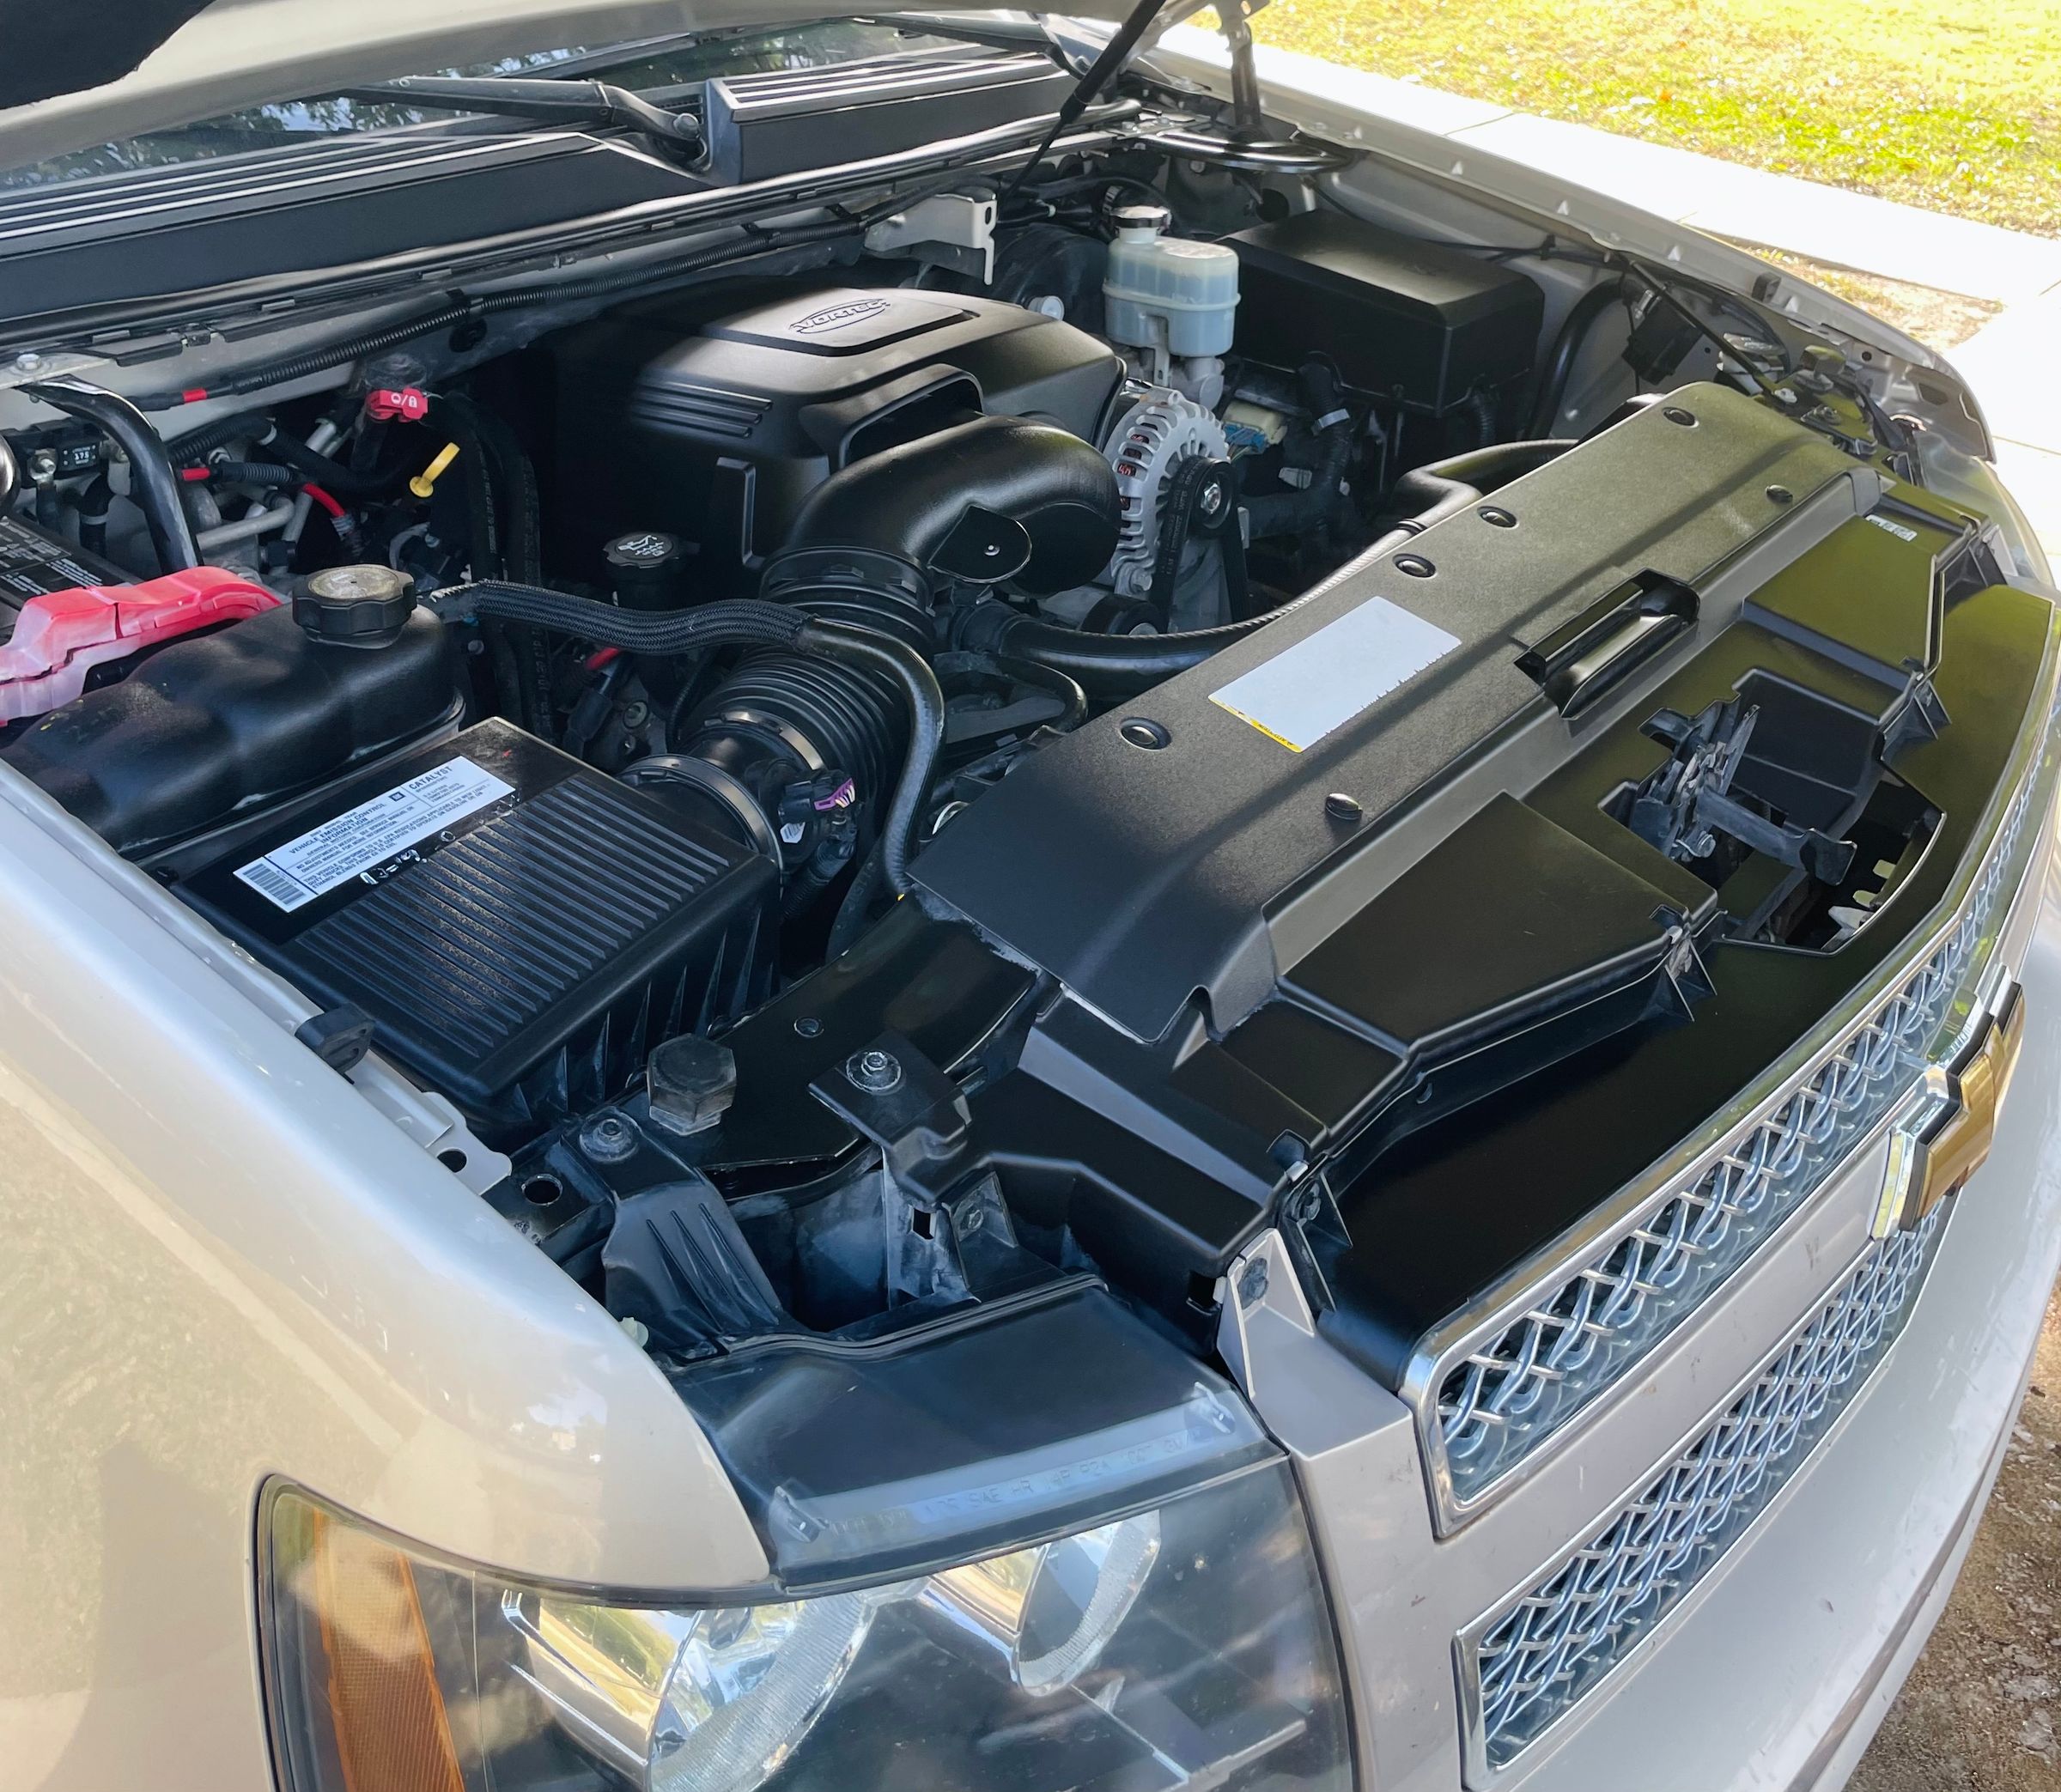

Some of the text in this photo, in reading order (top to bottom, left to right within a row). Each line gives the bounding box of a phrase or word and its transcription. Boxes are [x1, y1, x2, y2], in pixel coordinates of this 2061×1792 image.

[790, 301, 891, 332] VORTEC
[408, 766, 453, 790] CATALYST
[289, 803, 386, 853] VEHICLE EMISSION CONTROL
[316, 863, 338, 875] VEHICLE
[337, 848, 366, 864] CONFORMS
[426, 801, 454, 817] APPLICABLE
[319, 817, 368, 843] INFORMATION
[303, 846, 338, 865] ADJUSTMENTS
[368, 820, 388, 830] SERVICE
[307, 843, 329, 855] GENERAL
[330, 831, 351, 842] MOTORS
[307, 877, 323, 885] DUTY
[357, 847, 378, 859] VEHICLE
[383, 830, 410, 844] CERTIFIED
[416, 815, 438, 827] OPERATE
[321, 849, 343, 861] MANUAL
[356, 855, 372, 865] FROM
[969, 1487, 1003, 1510] SAE
